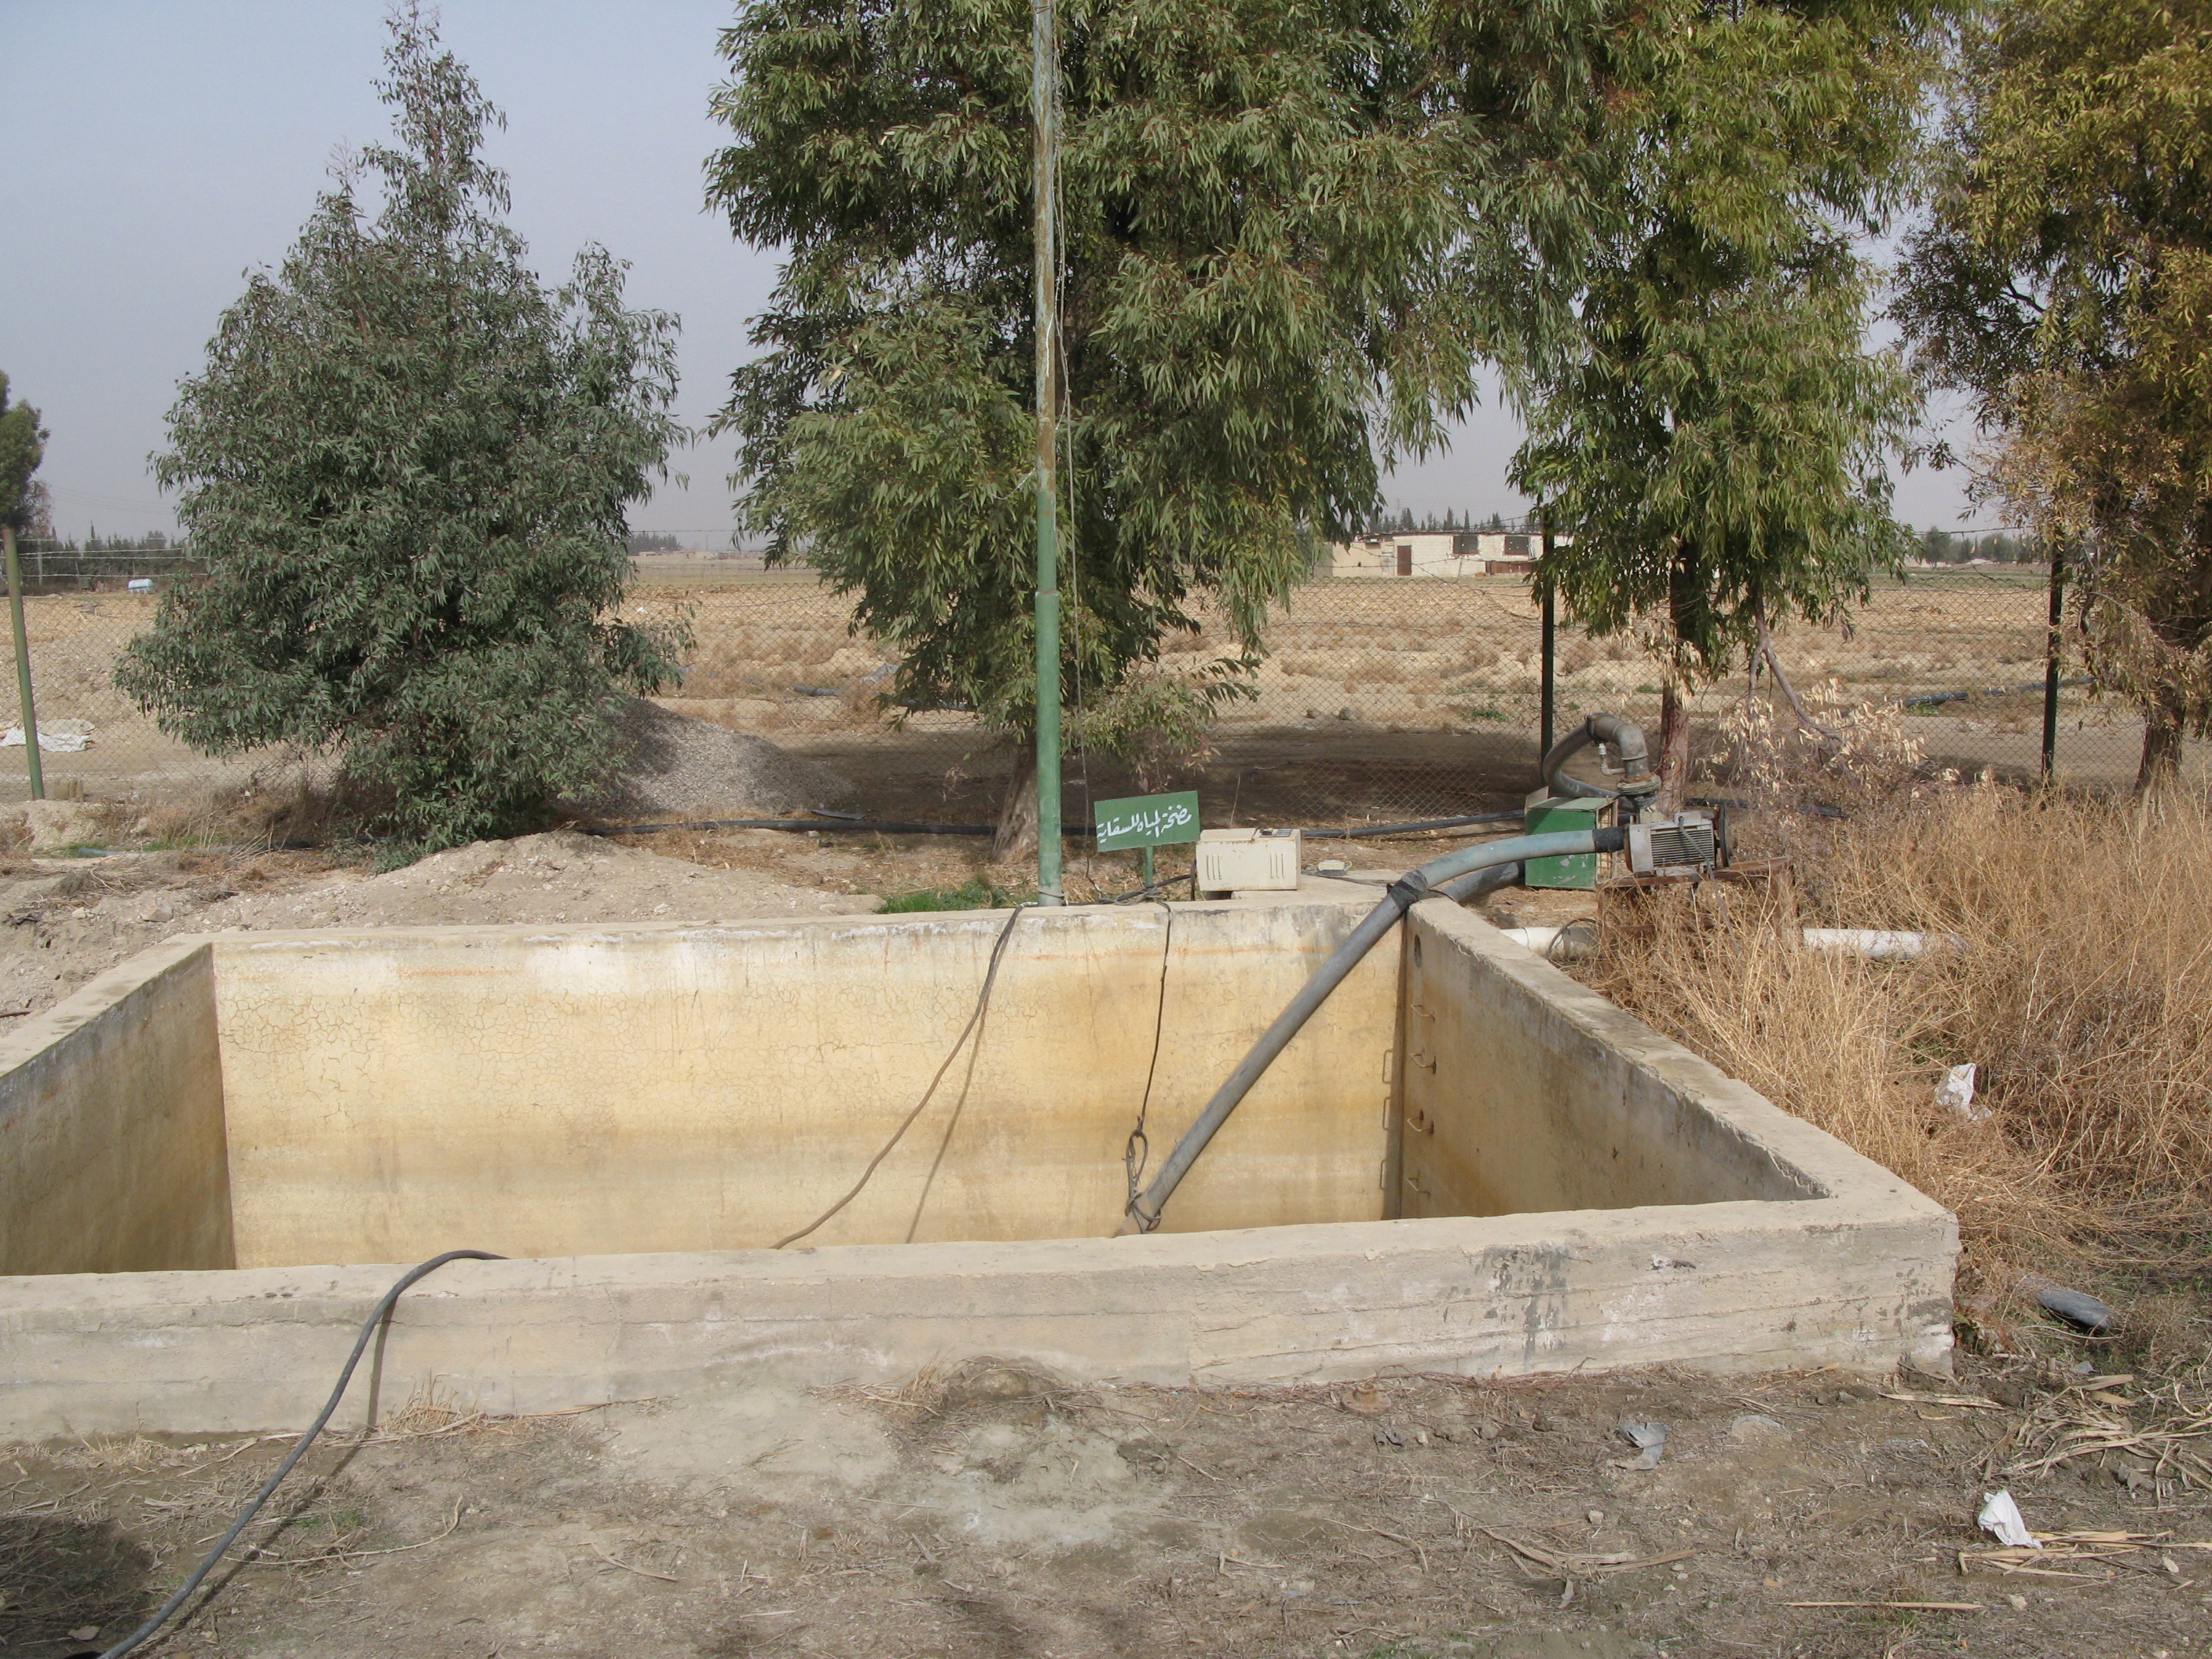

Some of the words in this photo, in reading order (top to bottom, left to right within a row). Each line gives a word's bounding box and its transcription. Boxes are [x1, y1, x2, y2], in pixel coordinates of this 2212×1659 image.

[1097, 813, 1139, 844] للسقاية
[1137, 810, 1161, 838] المياه
[1161, 804, 1192, 833] مضخة
